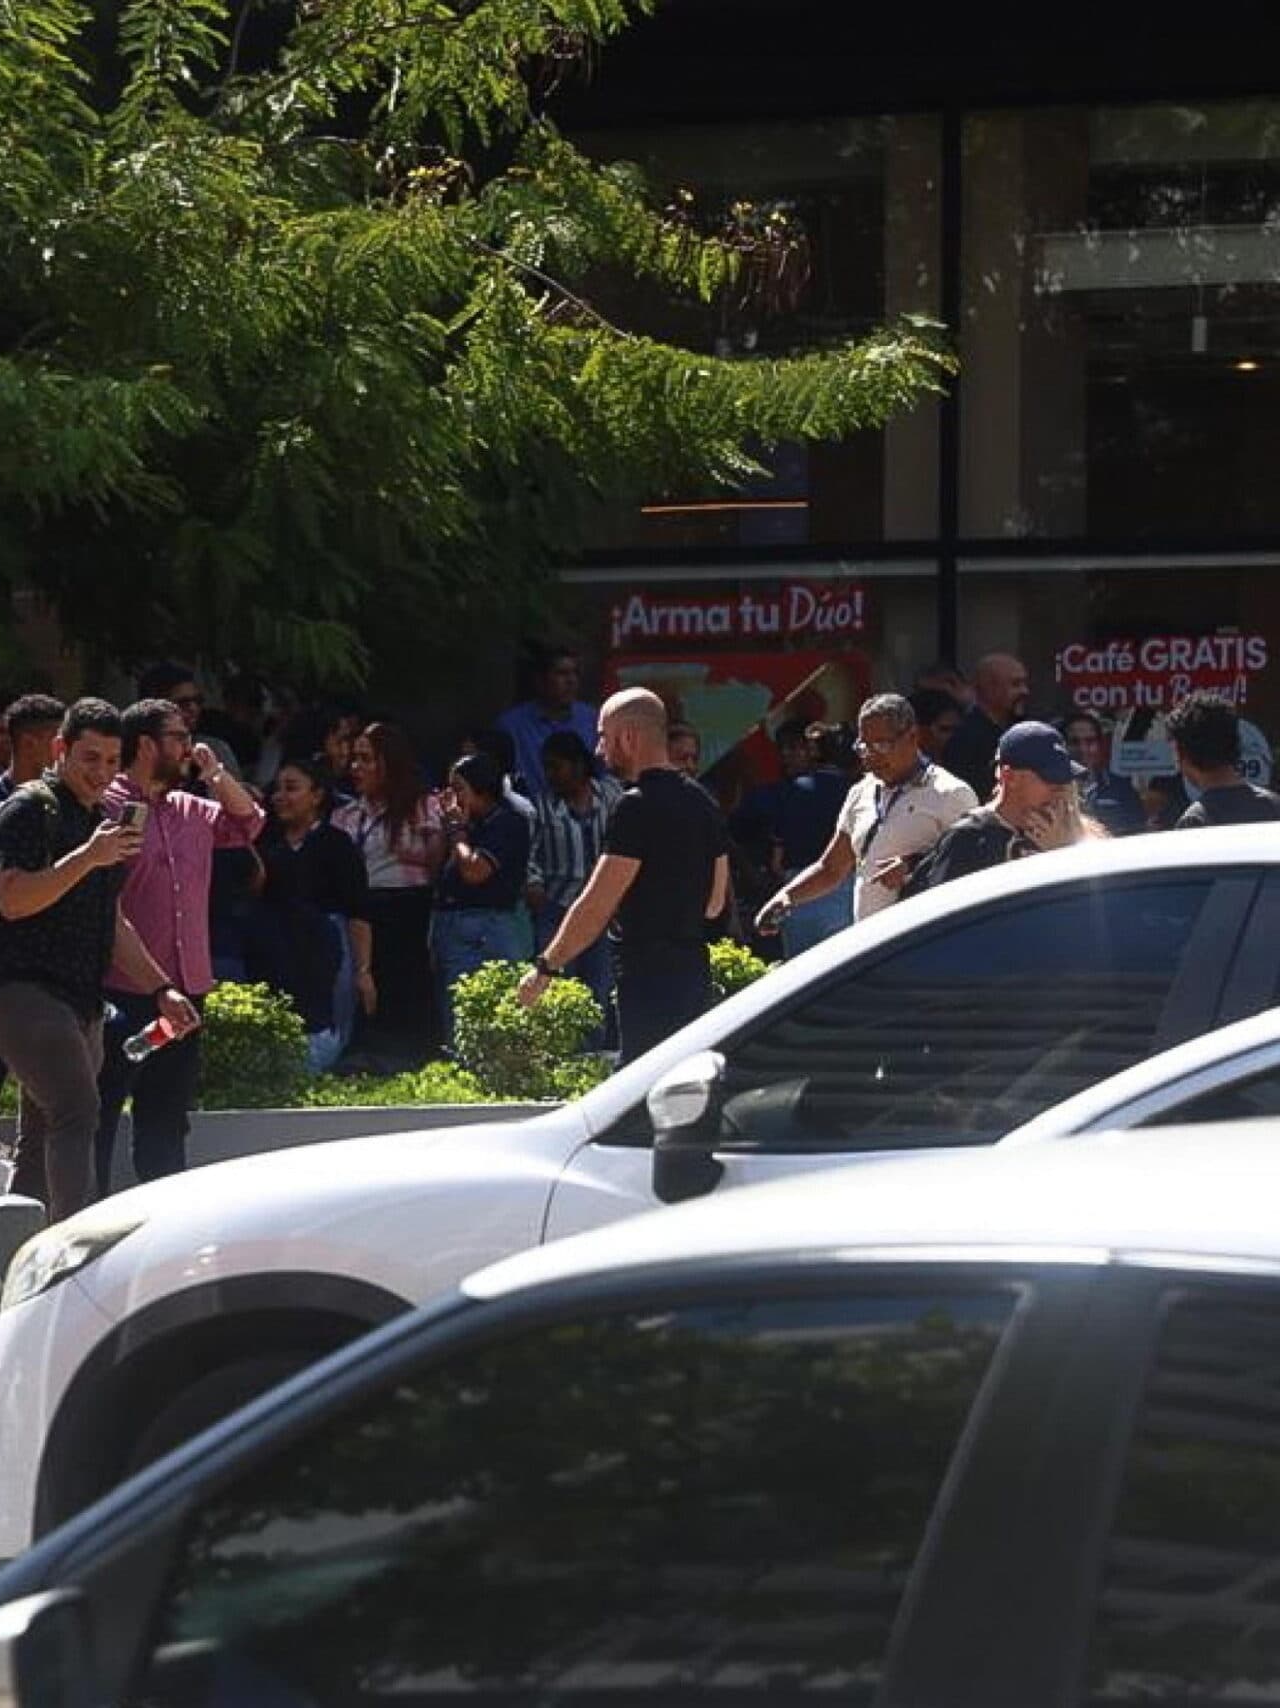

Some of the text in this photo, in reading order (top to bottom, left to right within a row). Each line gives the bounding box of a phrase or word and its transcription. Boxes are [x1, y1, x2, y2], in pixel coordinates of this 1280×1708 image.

[610, 587, 865, 648] ¡Arma tu Dúo!
[1055, 637, 1267, 683] ¡Café GRATIS
[1073, 685, 1129, 706] con
[1135, 679, 1165, 705] tu
